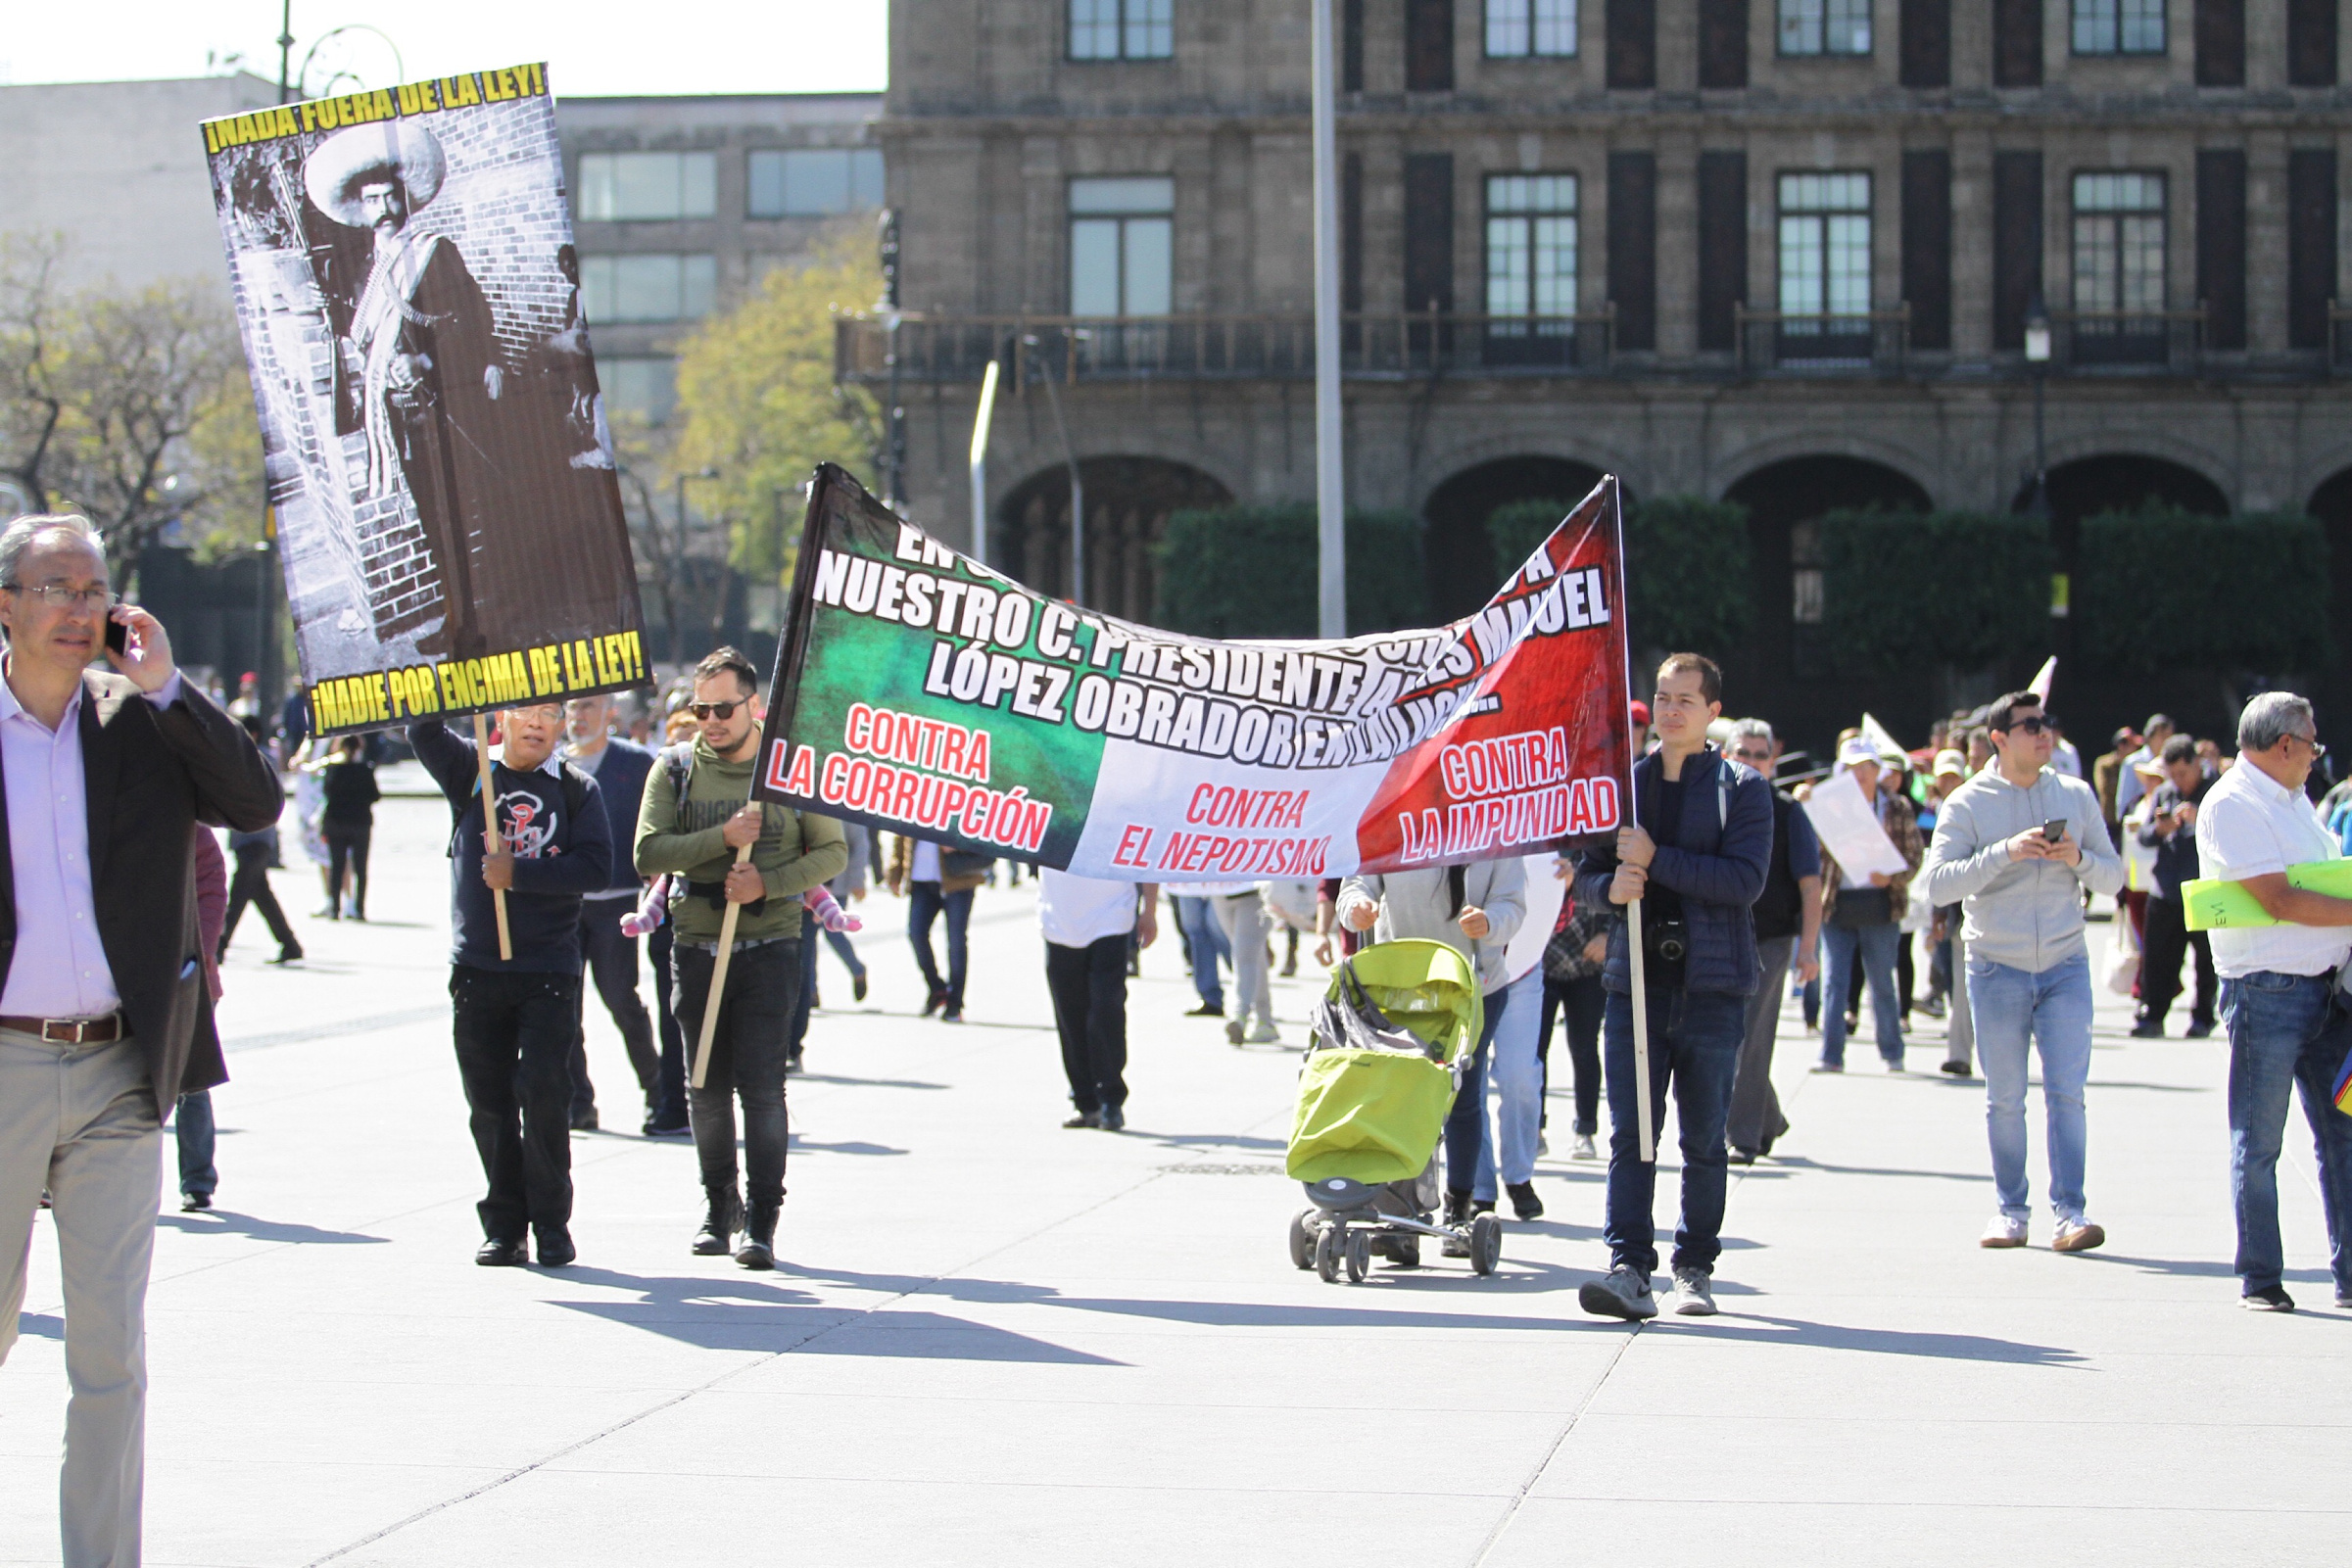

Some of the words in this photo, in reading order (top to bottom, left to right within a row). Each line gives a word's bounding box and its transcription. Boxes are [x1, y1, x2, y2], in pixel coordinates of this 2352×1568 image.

[206, 109, 298, 153] ¡NADA
[302, 89, 395, 132] FUERA
[397, 80, 440, 117] DE
[441, 73, 481, 109] LA
[483, 62, 545, 102] LEY!
[812, 548, 1032, 649] NUESTRO
[1037, 599, 1081, 662] C.
[1081, 614, 1368, 717] PRESIDENTE
[312, 672, 390, 736] ¡NADIE
[388, 665, 440, 718] POR
[437, 649, 532, 711] ENCIMA
[529, 643, 564, 697] DE
[561, 639, 596, 690] LA
[593, 630, 645, 685] LEY!
[923, 637, 1073, 725] LÓPEZ
[1071, 671, 1297, 770] OBRADOR
[844, 702, 991, 783] CONTRA
[1438, 727, 1568, 799] CONTRA
[764, 737, 816, 799] LA
[819, 751, 1053, 853] CORRUPCIÓN
[1185, 782, 1312, 831] CONTRA
[1399, 805, 1442, 864] LA
[1444, 775, 1621, 857] IMPUNIDAD
[1112, 824, 1154, 871] EL
[1157, 831, 1331, 879] NEPOTISMO
